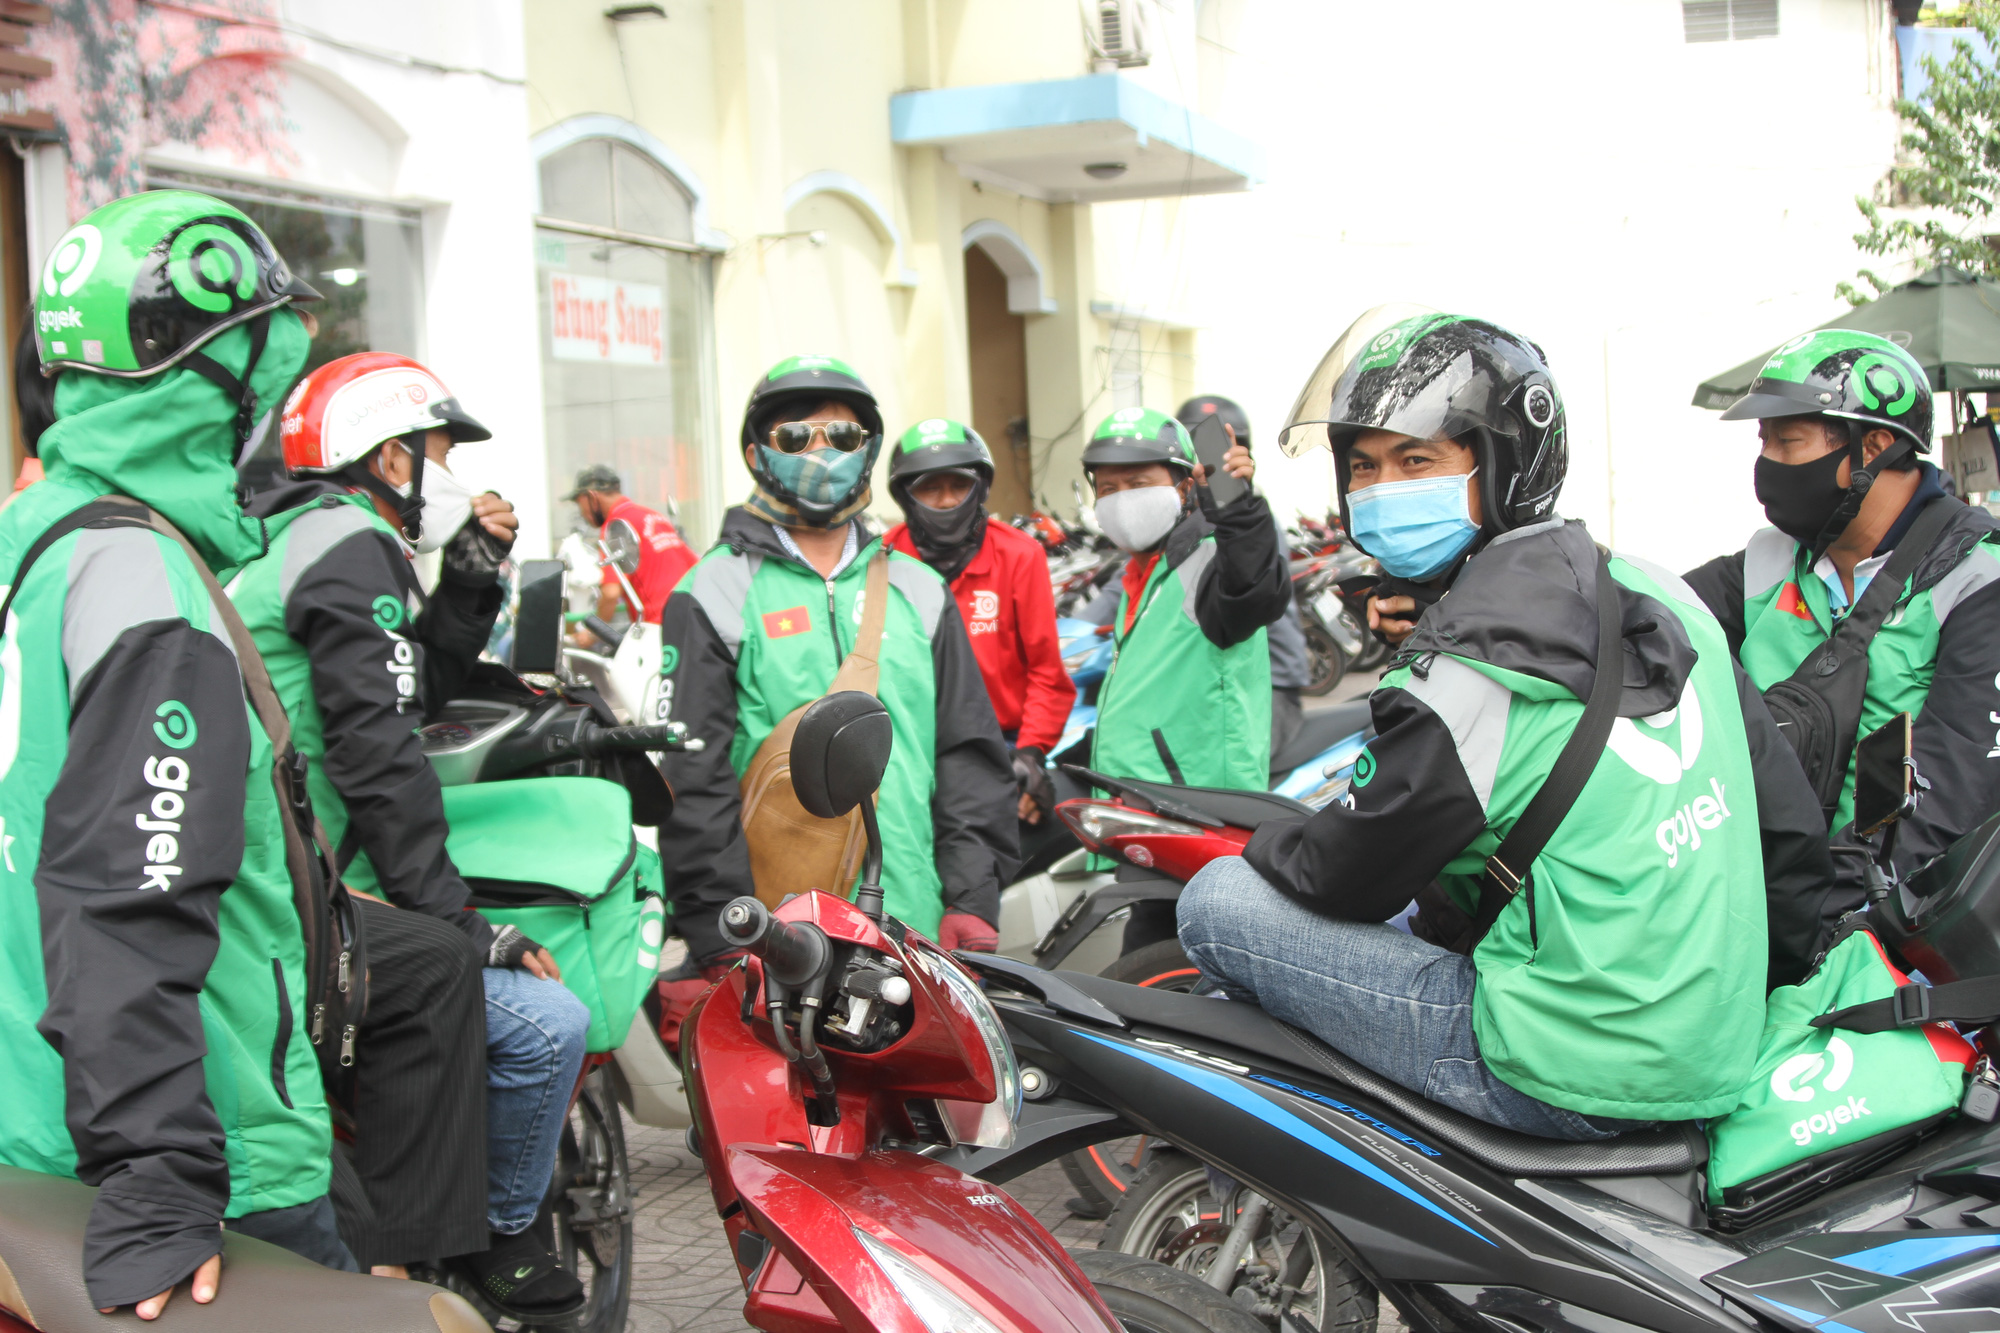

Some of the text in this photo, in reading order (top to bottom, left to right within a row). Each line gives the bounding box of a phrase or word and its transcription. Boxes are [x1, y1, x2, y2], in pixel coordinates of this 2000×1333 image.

[38, 305, 85, 333] gojek
[614, 285, 663, 363] Sang
[1534, 493, 1553, 515] gojek
[970, 619, 998, 635] govi
[135, 755, 190, 892] gojek
[1655, 776, 1732, 869] gojek
[1789, 1095, 1873, 1147] gojek
[1360, 1134, 1483, 1213] FUEL INJECTION
